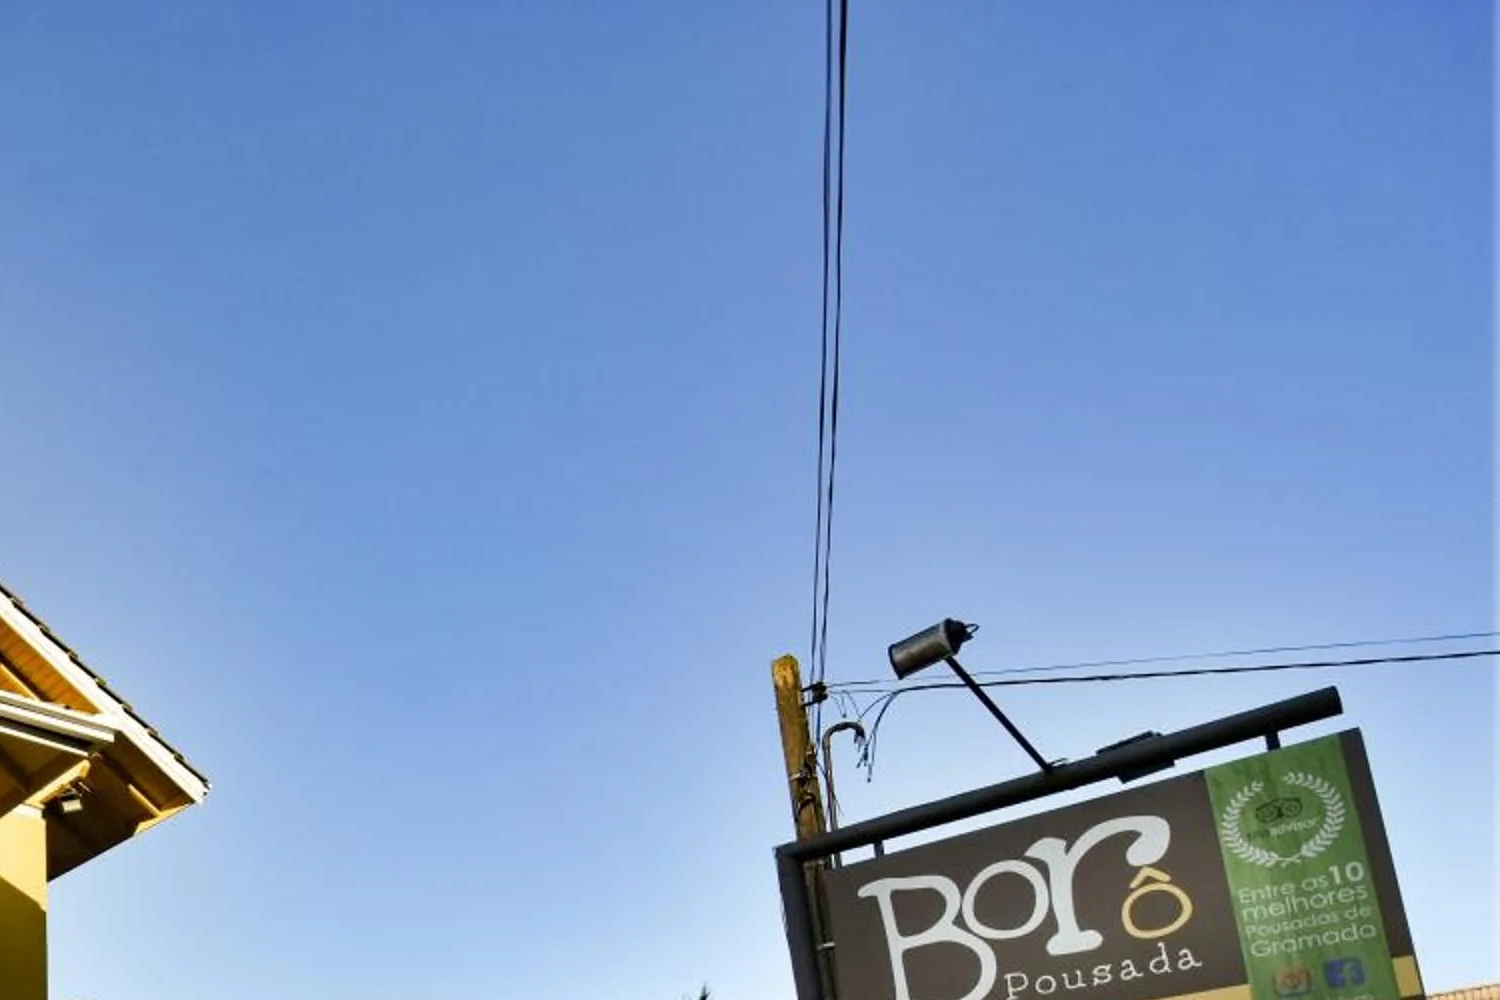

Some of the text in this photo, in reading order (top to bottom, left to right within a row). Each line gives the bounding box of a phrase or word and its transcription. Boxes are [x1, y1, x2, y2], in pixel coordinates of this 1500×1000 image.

[1238, 883, 1296, 904] Entre
[1329, 861, 1364, 886] 10
[1243, 885, 1368, 922] melhores
[1245, 905, 1373, 939] Pousadas de
[1251, 923, 1377, 957] Gramado
[1004, 942, 1203, 1000] Pousada
